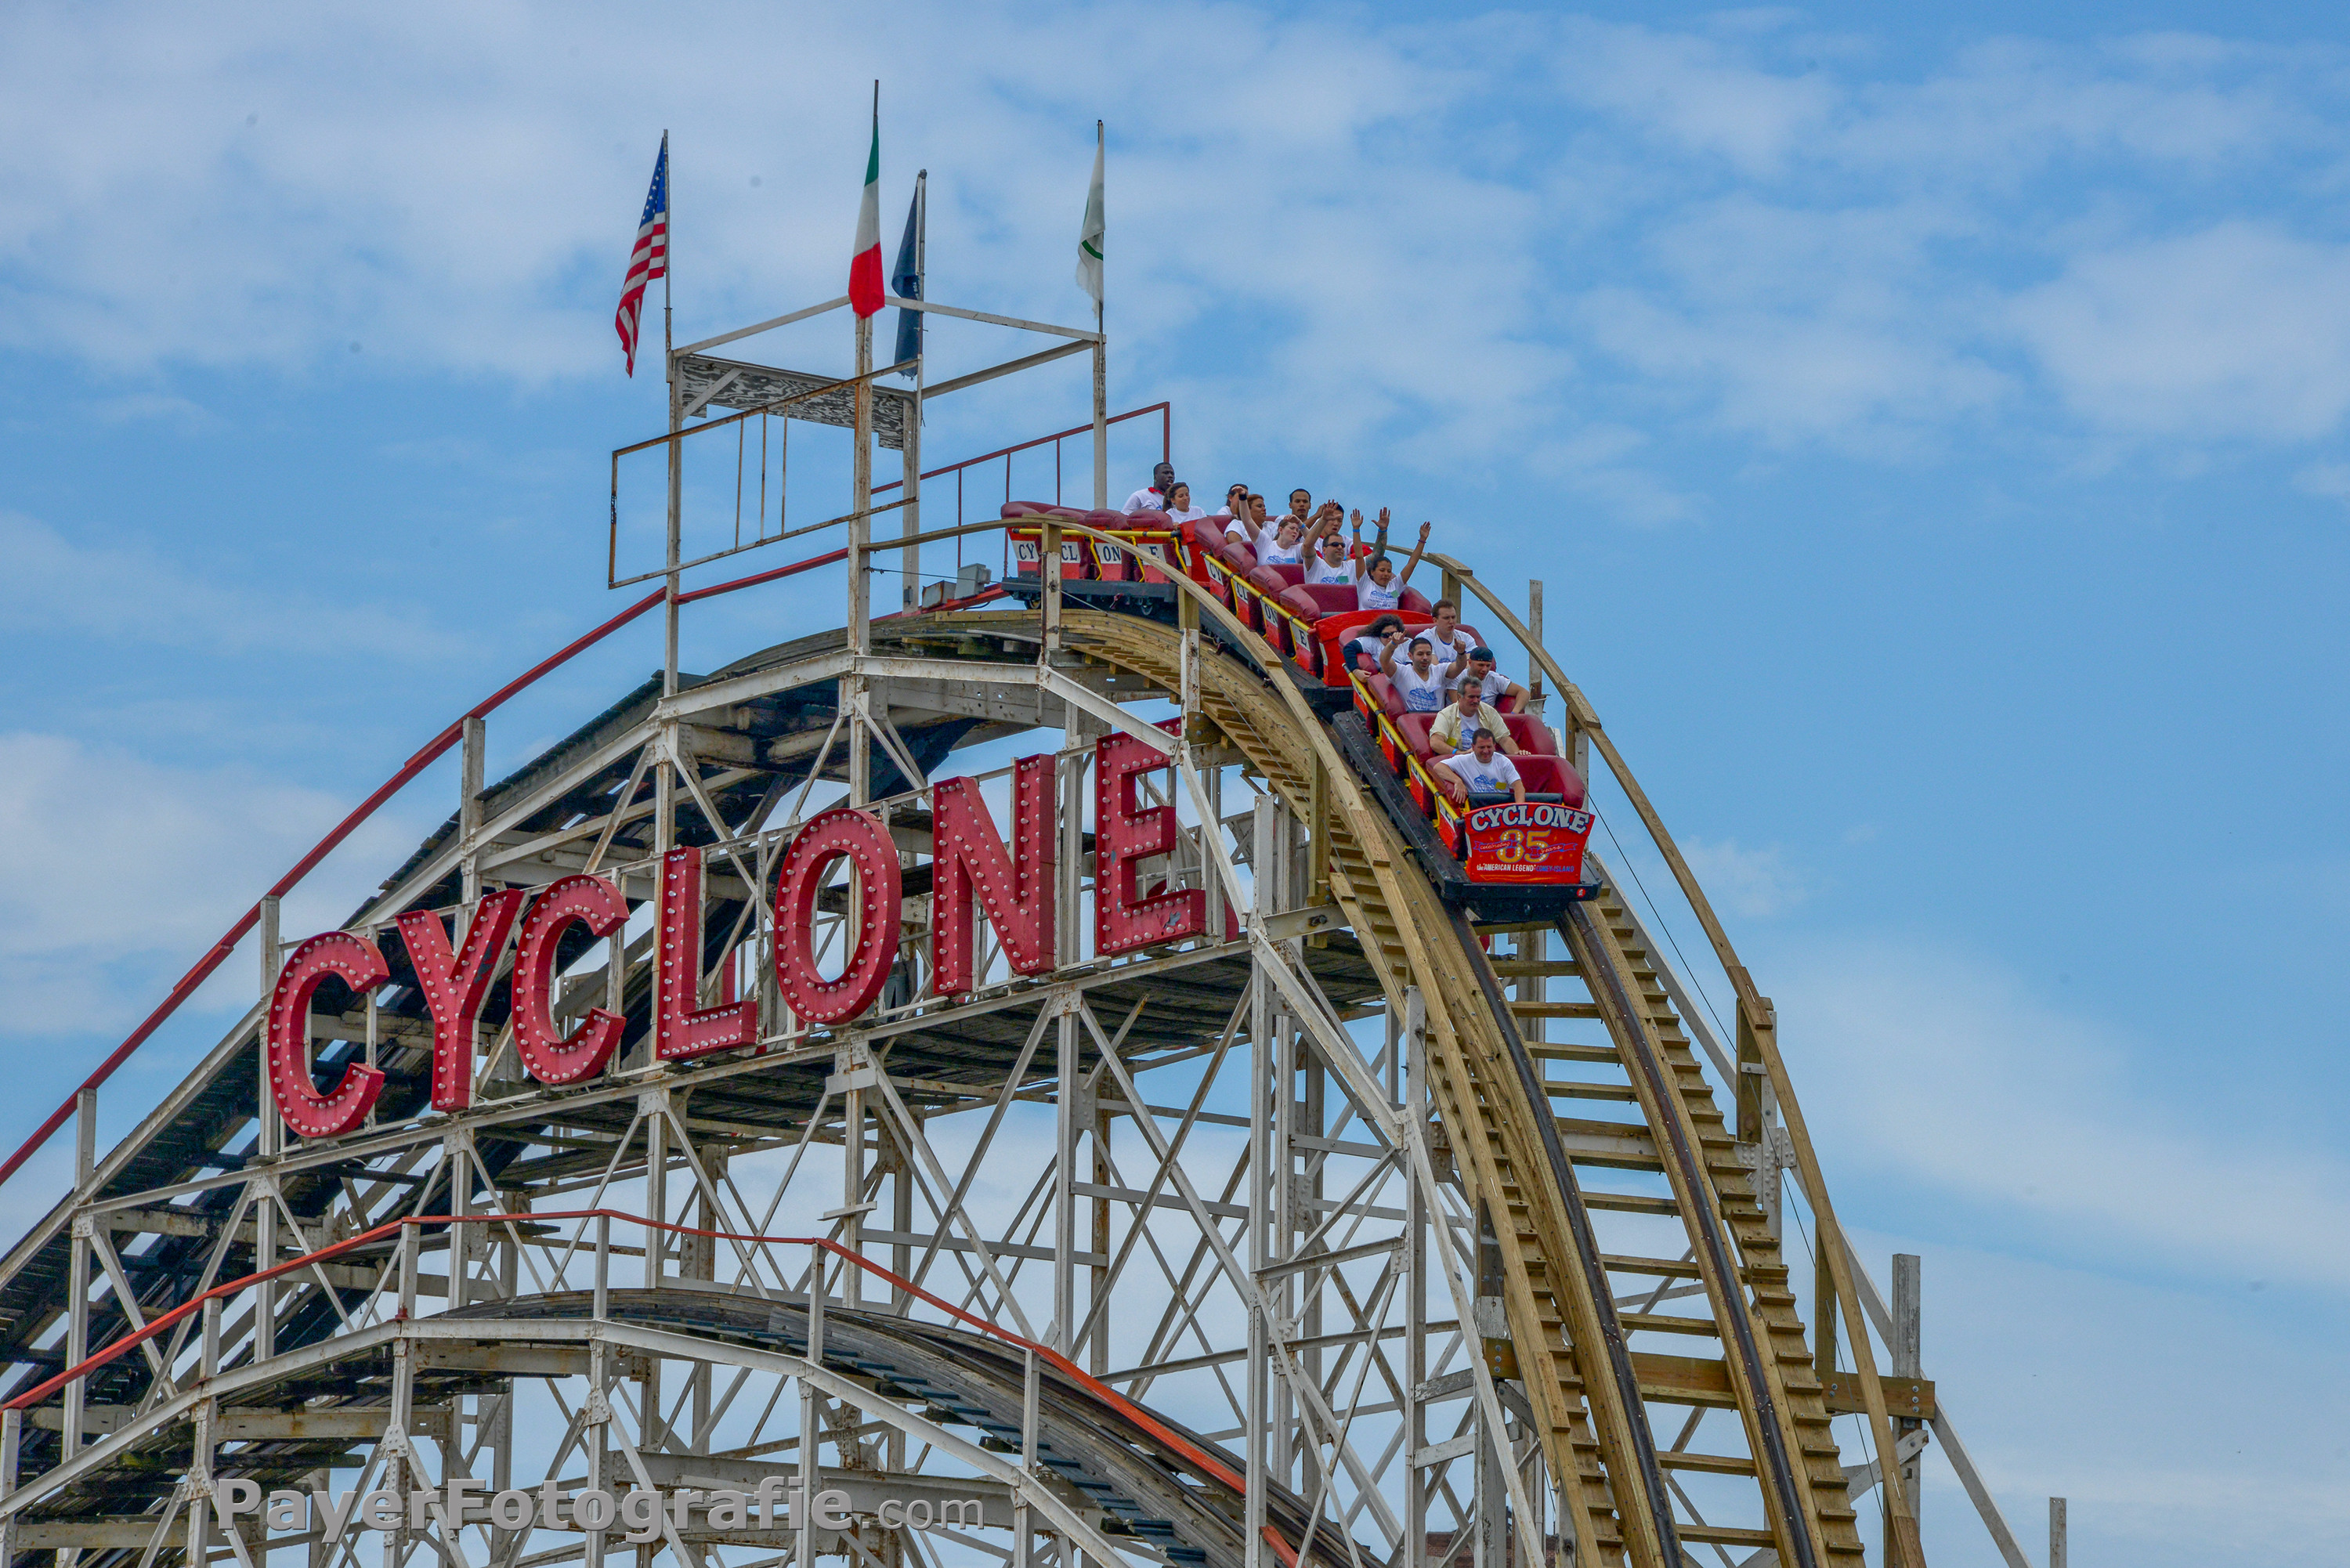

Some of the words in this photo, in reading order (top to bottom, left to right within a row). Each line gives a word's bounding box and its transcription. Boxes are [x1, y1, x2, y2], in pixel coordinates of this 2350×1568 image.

[1018, 543, 1035, 560] CY
[1103, 545, 1121, 562] ON
[1209, 563, 1222, 582] CY
[1299, 630, 1307, 647] E
[1471, 804, 1589, 834] CYCLONE
[1496, 829, 1552, 863] 85
[268, 717, 1206, 1137] CYCLONE
